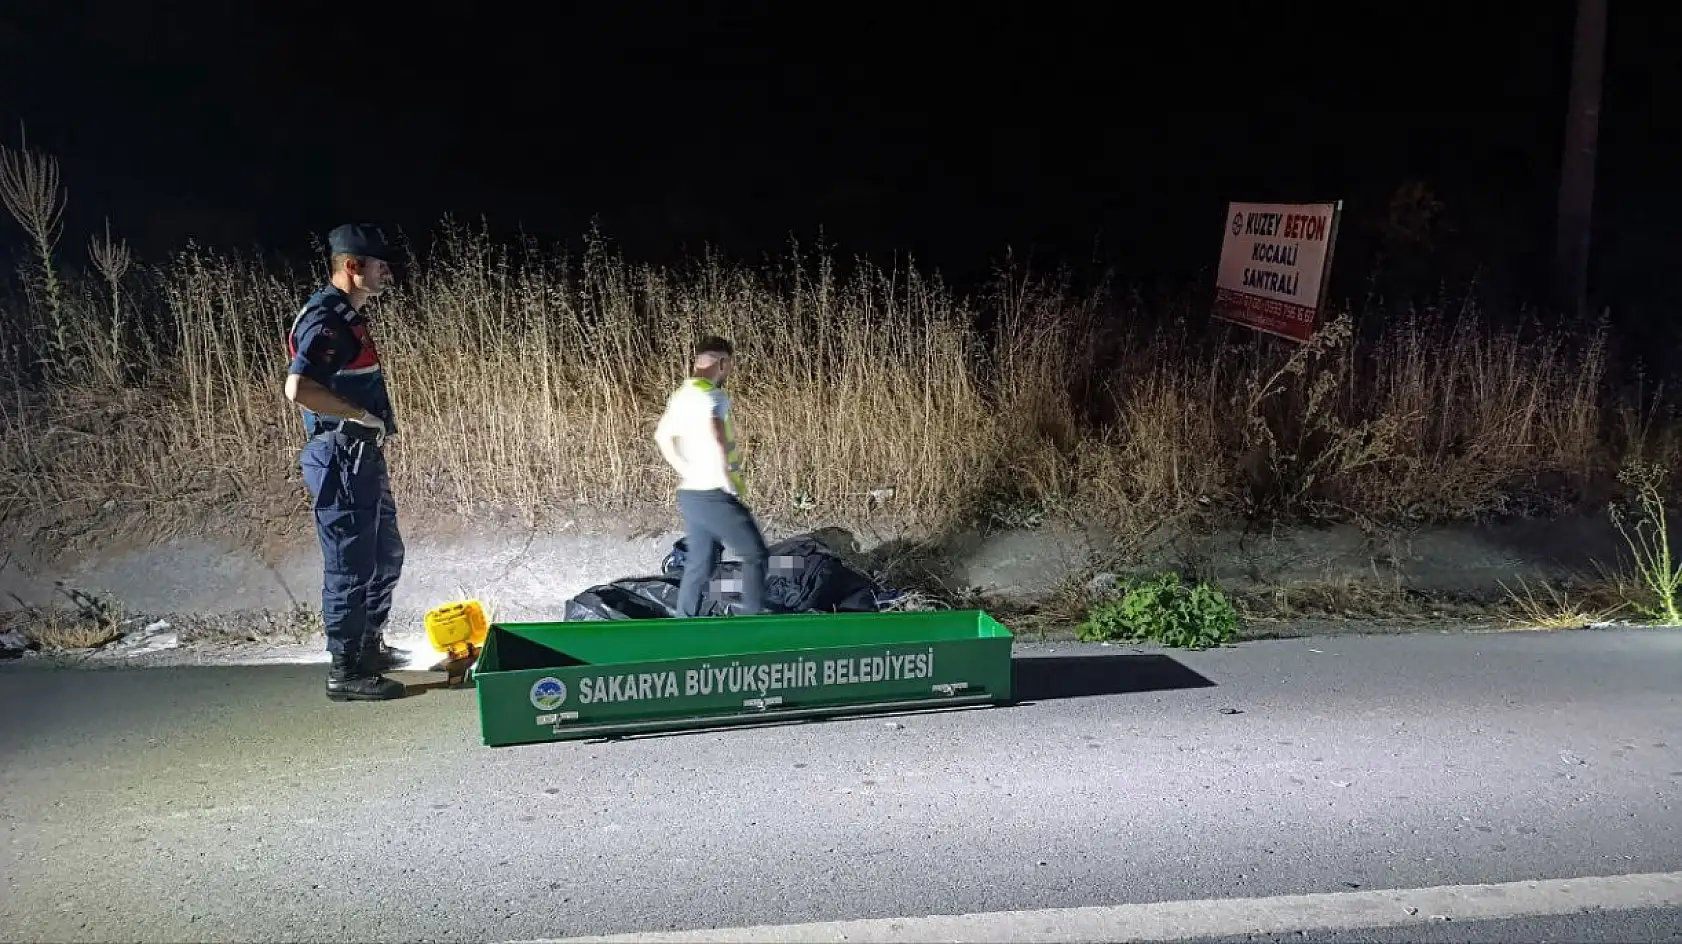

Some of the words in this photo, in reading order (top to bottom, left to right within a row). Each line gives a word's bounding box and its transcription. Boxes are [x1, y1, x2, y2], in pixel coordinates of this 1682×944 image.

[1245, 212, 1283, 237] KUZEY
[1284, 214, 1326, 241] BETON
[579, 671, 679, 704] SAKARYA
[685, 657, 817, 697] BÜYÜKŞEHİR
[823, 647, 933, 686] BELEDİYESİ
